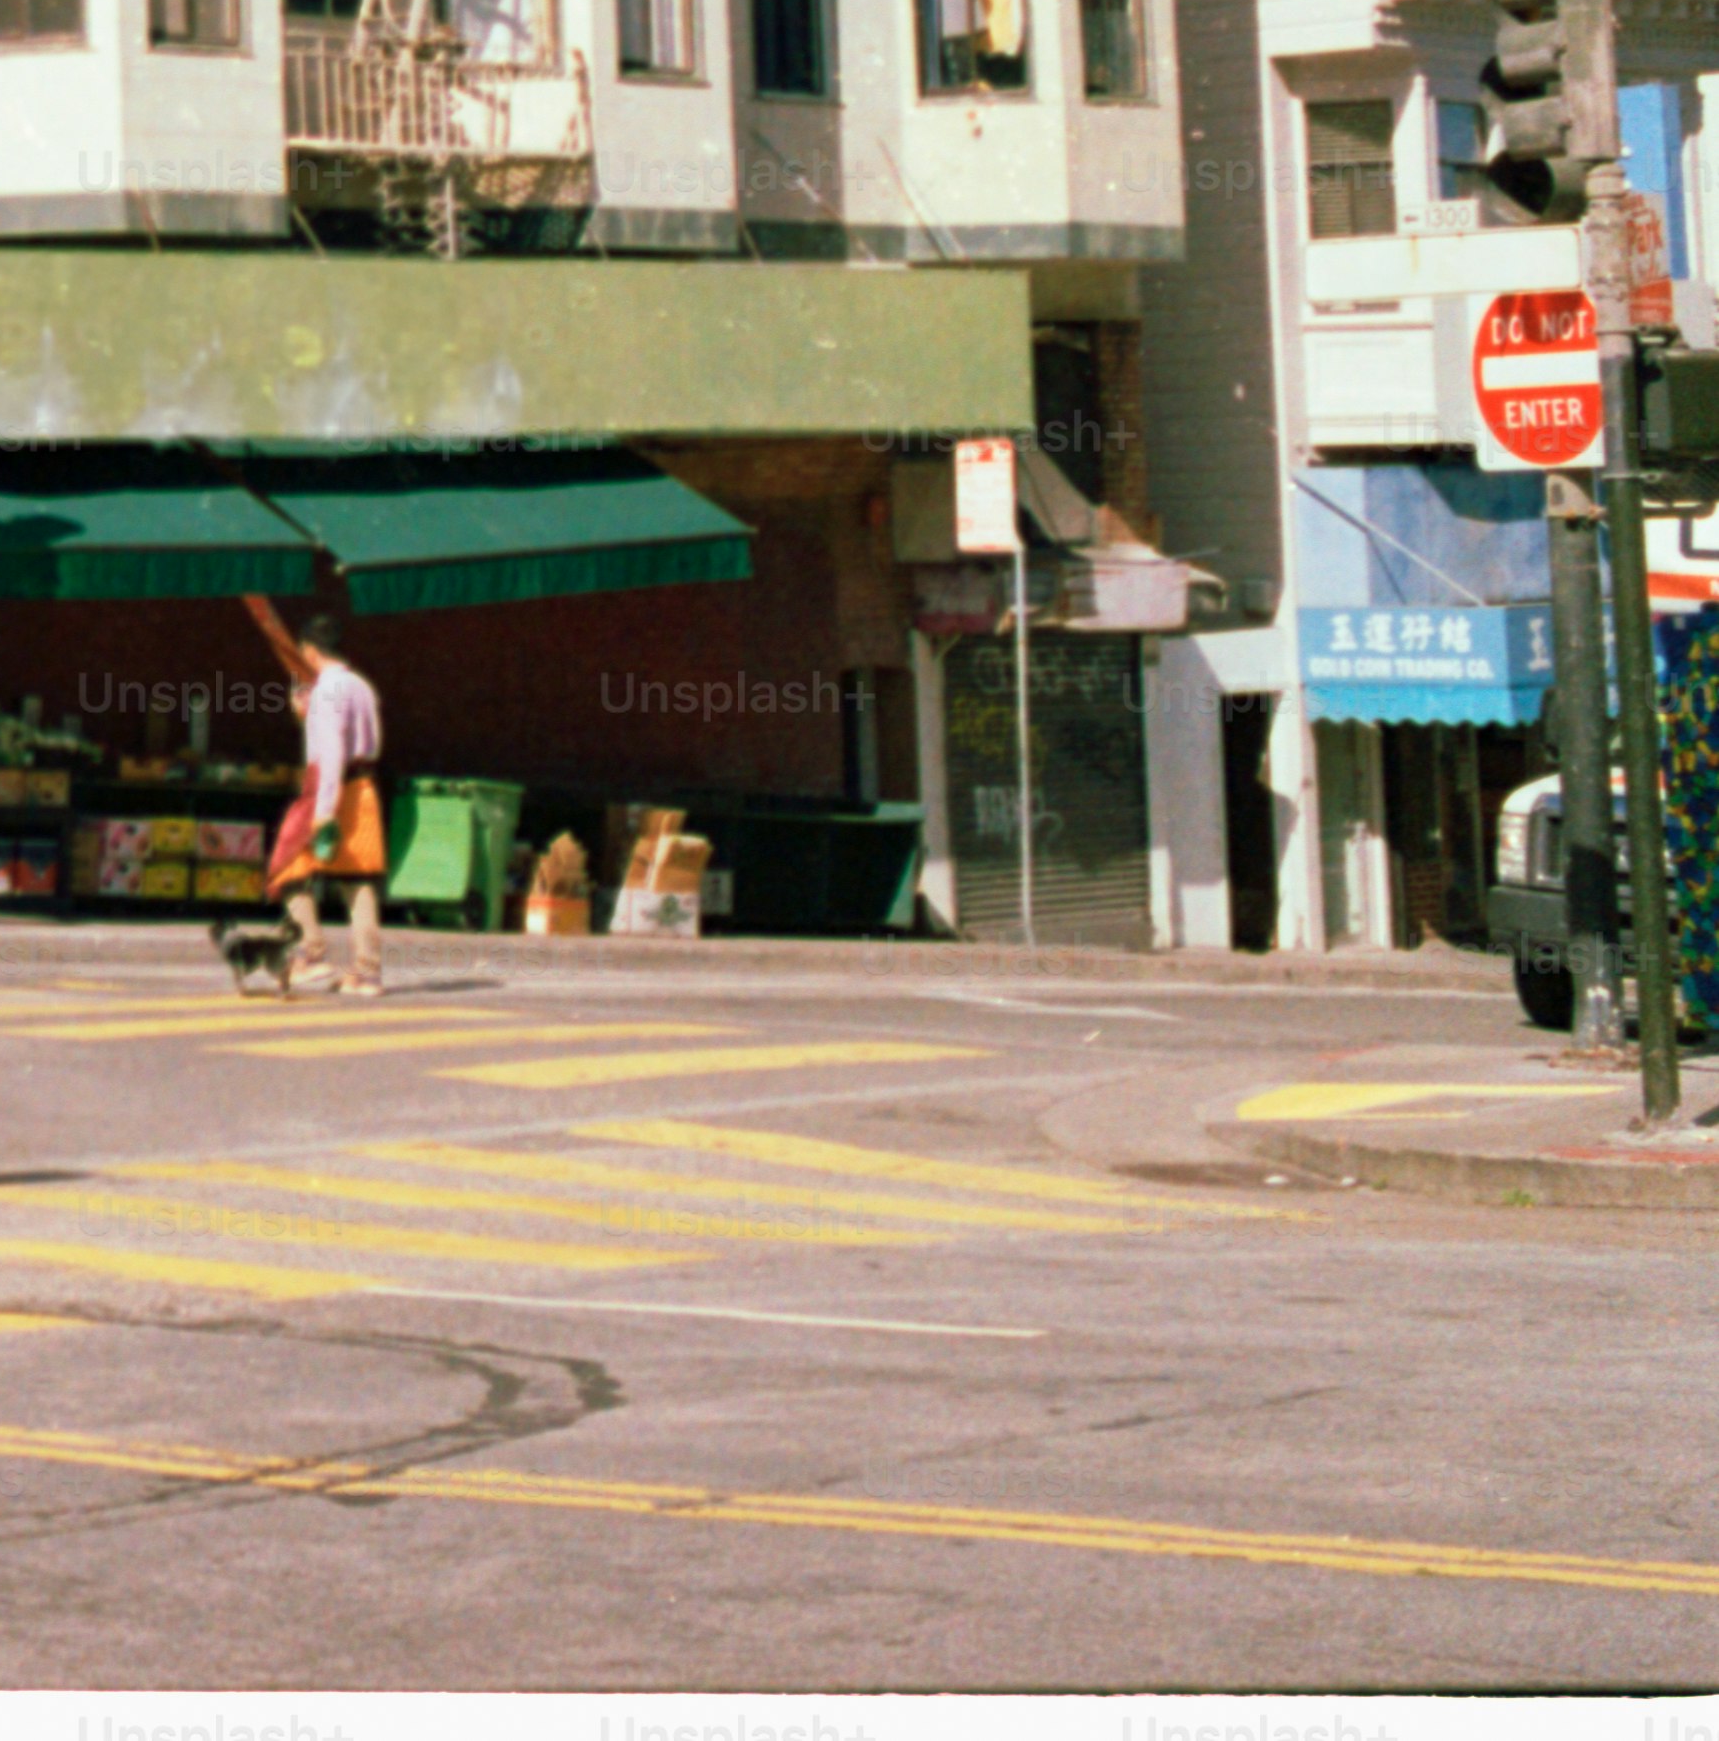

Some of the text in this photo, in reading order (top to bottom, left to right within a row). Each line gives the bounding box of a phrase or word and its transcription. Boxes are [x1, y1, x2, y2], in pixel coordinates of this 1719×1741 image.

[1425, 206, 1470, 227] 1300
[1492, 310, 1587, 345] DO NOT
[1504, 396, 1584, 428] ENTER
